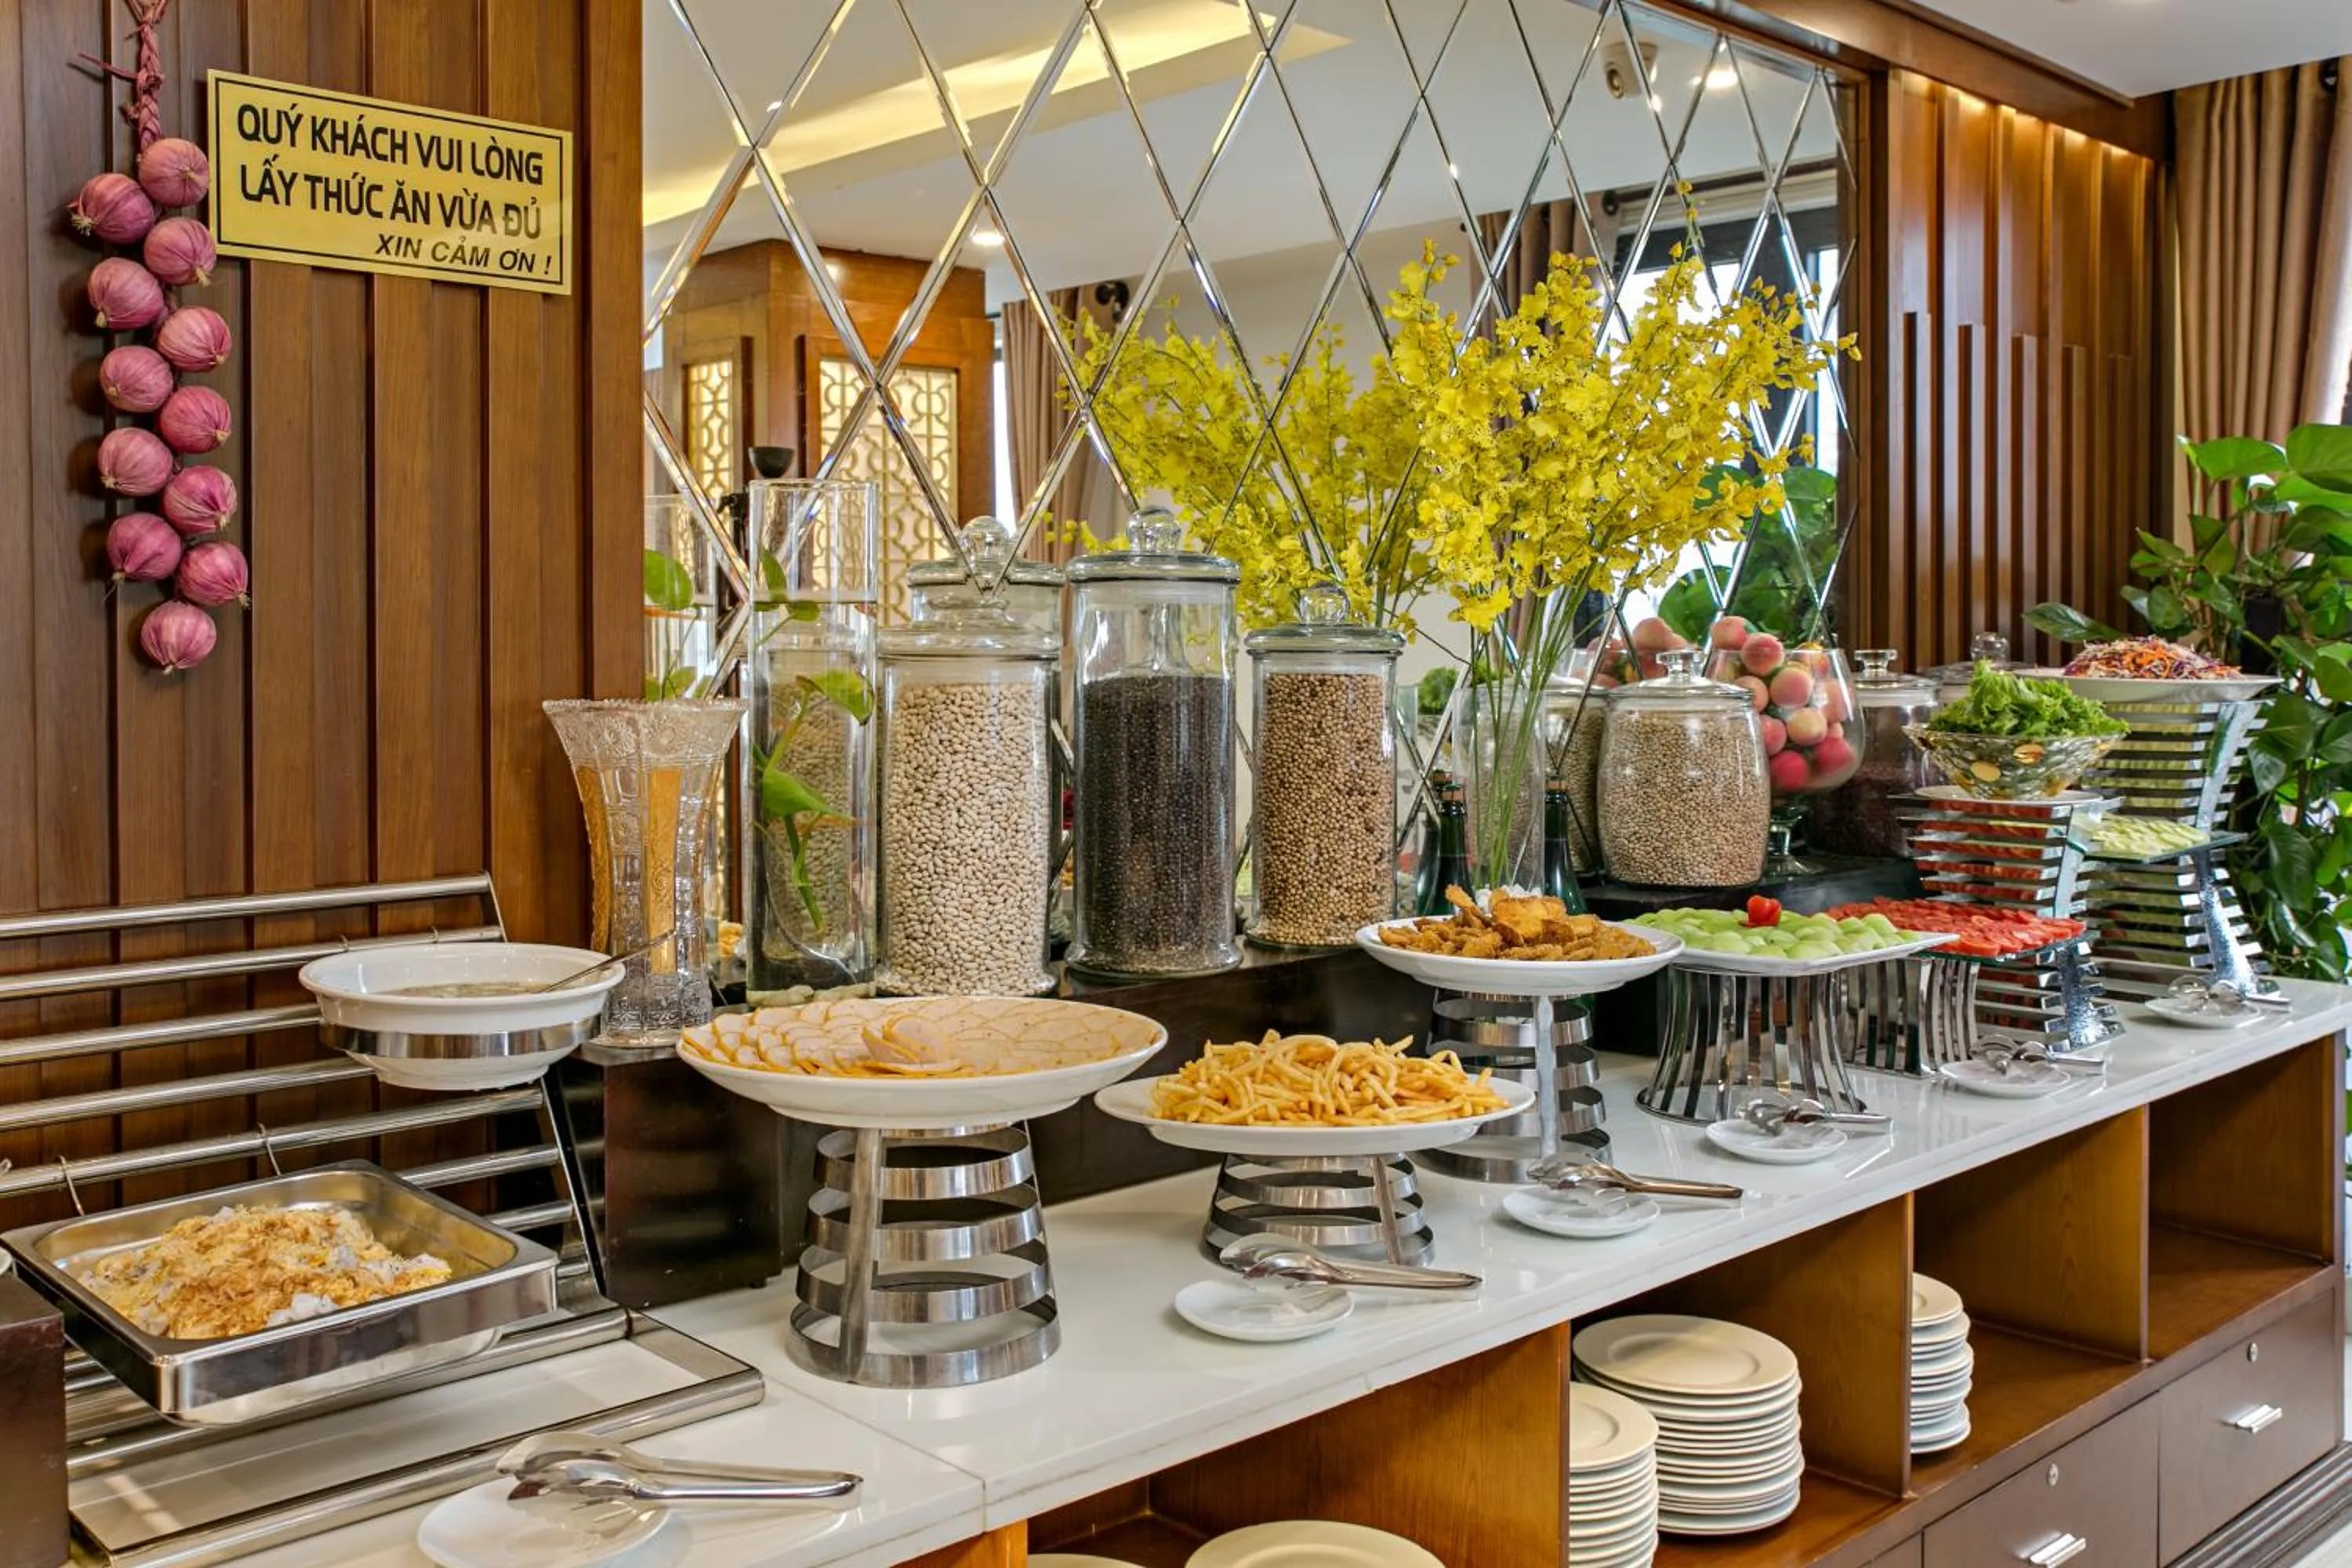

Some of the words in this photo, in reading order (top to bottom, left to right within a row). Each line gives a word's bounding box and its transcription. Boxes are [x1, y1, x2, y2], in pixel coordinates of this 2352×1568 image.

[238, 103, 303, 147] QUÝ
[311, 114, 408, 165] KHÁCH
[416, 132, 463, 173] VUI
[470, 136, 543, 185] LÒNG
[240, 154, 298, 206] LẤY
[304, 172, 383, 219] THỨC
[390, 179, 430, 225] ĂN
[437, 188, 497, 234] VỪA
[502, 197, 541, 239] ĐỦ
[376, 234, 423, 260] XIN
[430, 237, 489, 267] CẢM
[499, 249, 536, 274] ƠN
[544, 255, 552, 275] !
